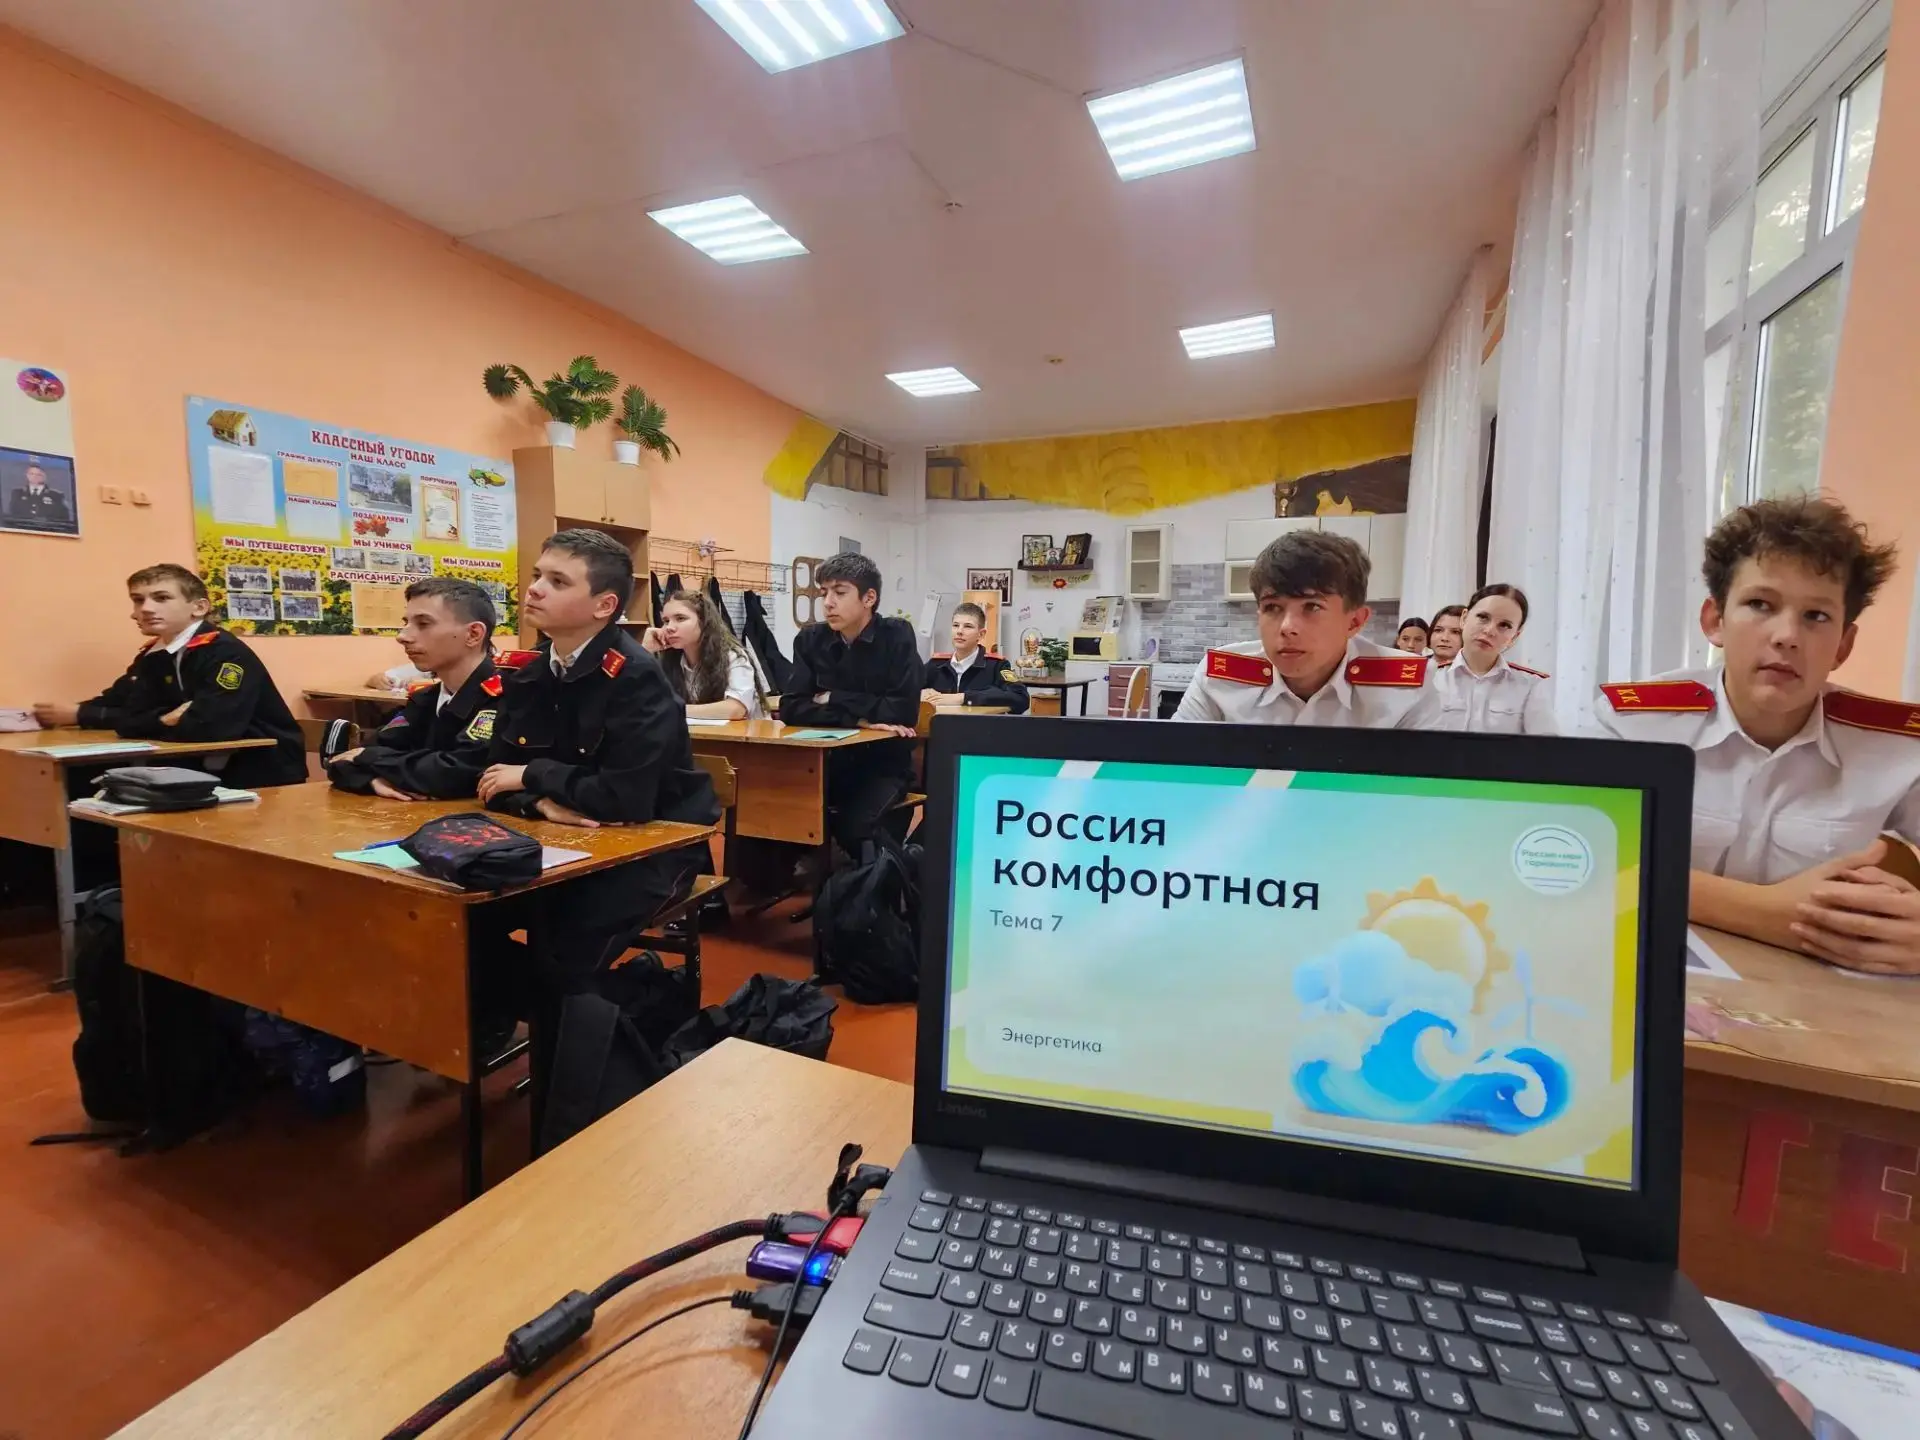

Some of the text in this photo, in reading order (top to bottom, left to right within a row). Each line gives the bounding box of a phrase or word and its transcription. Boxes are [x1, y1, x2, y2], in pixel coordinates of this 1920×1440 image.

[312, 430, 436, 465] КЛАССНЫЙ УГОЛОК
[351, 453, 406, 469] НАШ КЛАСС
[225, 538, 326, 554] МЫ ПУТЕШЕСТВУЕМ
[353, 539, 412, 551] МЫ УЧИМСЯ
[443, 557, 501, 569] МЫ ОТДЫХАЕМ
[330, 571, 395, 583] РАСПИСАНИЕ
[995, 799, 1166, 846] Россия
[993, 854, 1320, 911] комфортная
[989, 909, 1064, 932] Тема 7
[1001, 1027, 1102, 1053] Энергетика
[990, 1229, 998, 1238] 2
[949, 1241, 960, 1253] Q
[1029, 1236, 1037, 1246] 3
[989, 1249, 1003, 1260] W
[1069, 1244, 1077, 1253] 4
[1111, 1251, 1119, 1261] 5
[1028, 1257, 1038, 1268] E
[1152, 1259, 1160, 1269] 6
[1069, 1265, 1080, 1275] R
[1195, 1267, 1203, 1276] 7
[951, 1275, 961, 1286] A
[1114, 1272, 1123, 1283] T
[1239, 1276, 1248, 1286] 8
[992, 1284, 1003, 1294] S
[1157, 1281, 1167, 1292] Y
[1284, 1285, 1293, 1295] 9
[1035, 1292, 1046, 1303] D
[1200, 1289, 1211, 1301] U
[1079, 1301, 1089, 1312] F
[1246, 1298, 1251, 1310] I
[1125, 1310, 1137, 1322] G
[1293, 1308, 1306, 1320] O
[960, 1314, 973, 1327] Z
[1170, 1319, 1182, 1331] H
[1341, 1317, 1351, 1328] P
[1005, 1324, 1018, 1336] X
[1219, 1329, 1228, 1341] J
[1052, 1334, 1064, 1346] C
[1267, 1340, 1279, 1352] K
[1100, 1343, 1111, 1356] V
[1147, 1353, 1159, 1366] B
[1316, 1349, 1328, 1363] L
[1197, 1363, 1210, 1378] N
[1248, 1375, 1264, 1390] M
